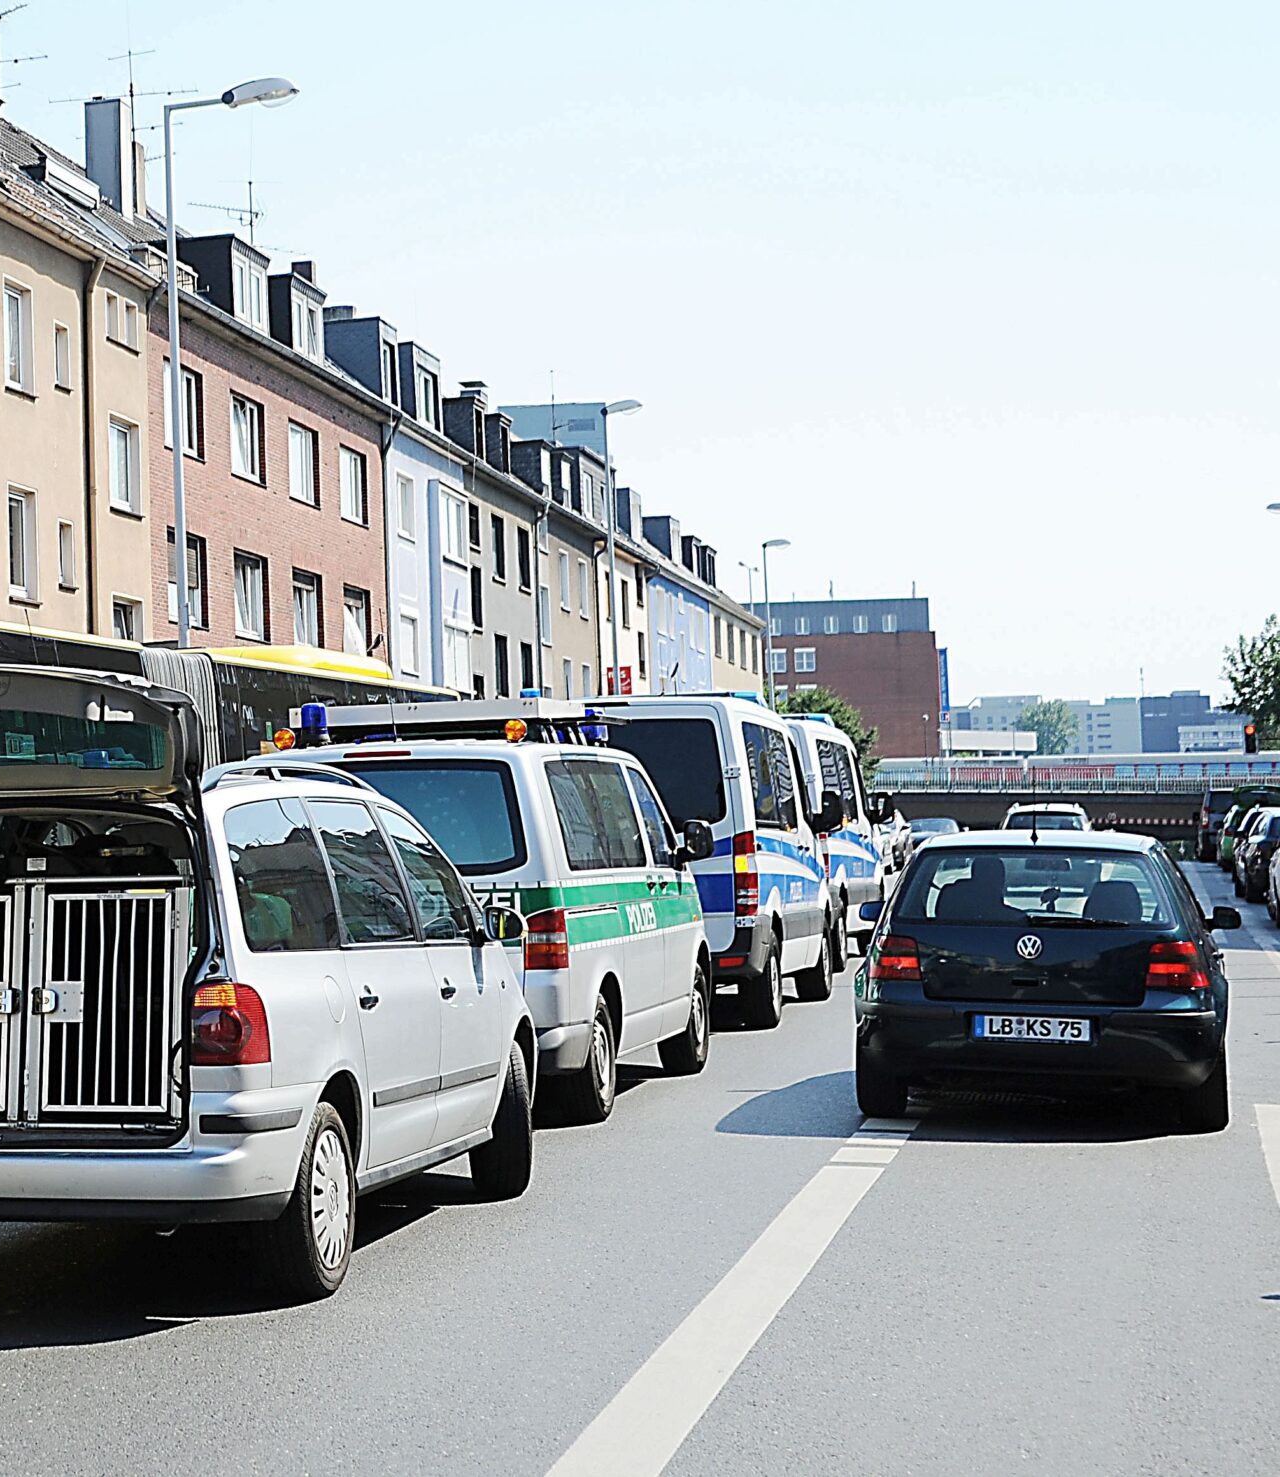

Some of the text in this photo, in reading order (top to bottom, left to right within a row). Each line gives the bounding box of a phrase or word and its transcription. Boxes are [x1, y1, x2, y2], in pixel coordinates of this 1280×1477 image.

[624, 902, 657, 934] POLIZEI
[988, 1018, 1082, 1039] LB KS 75
